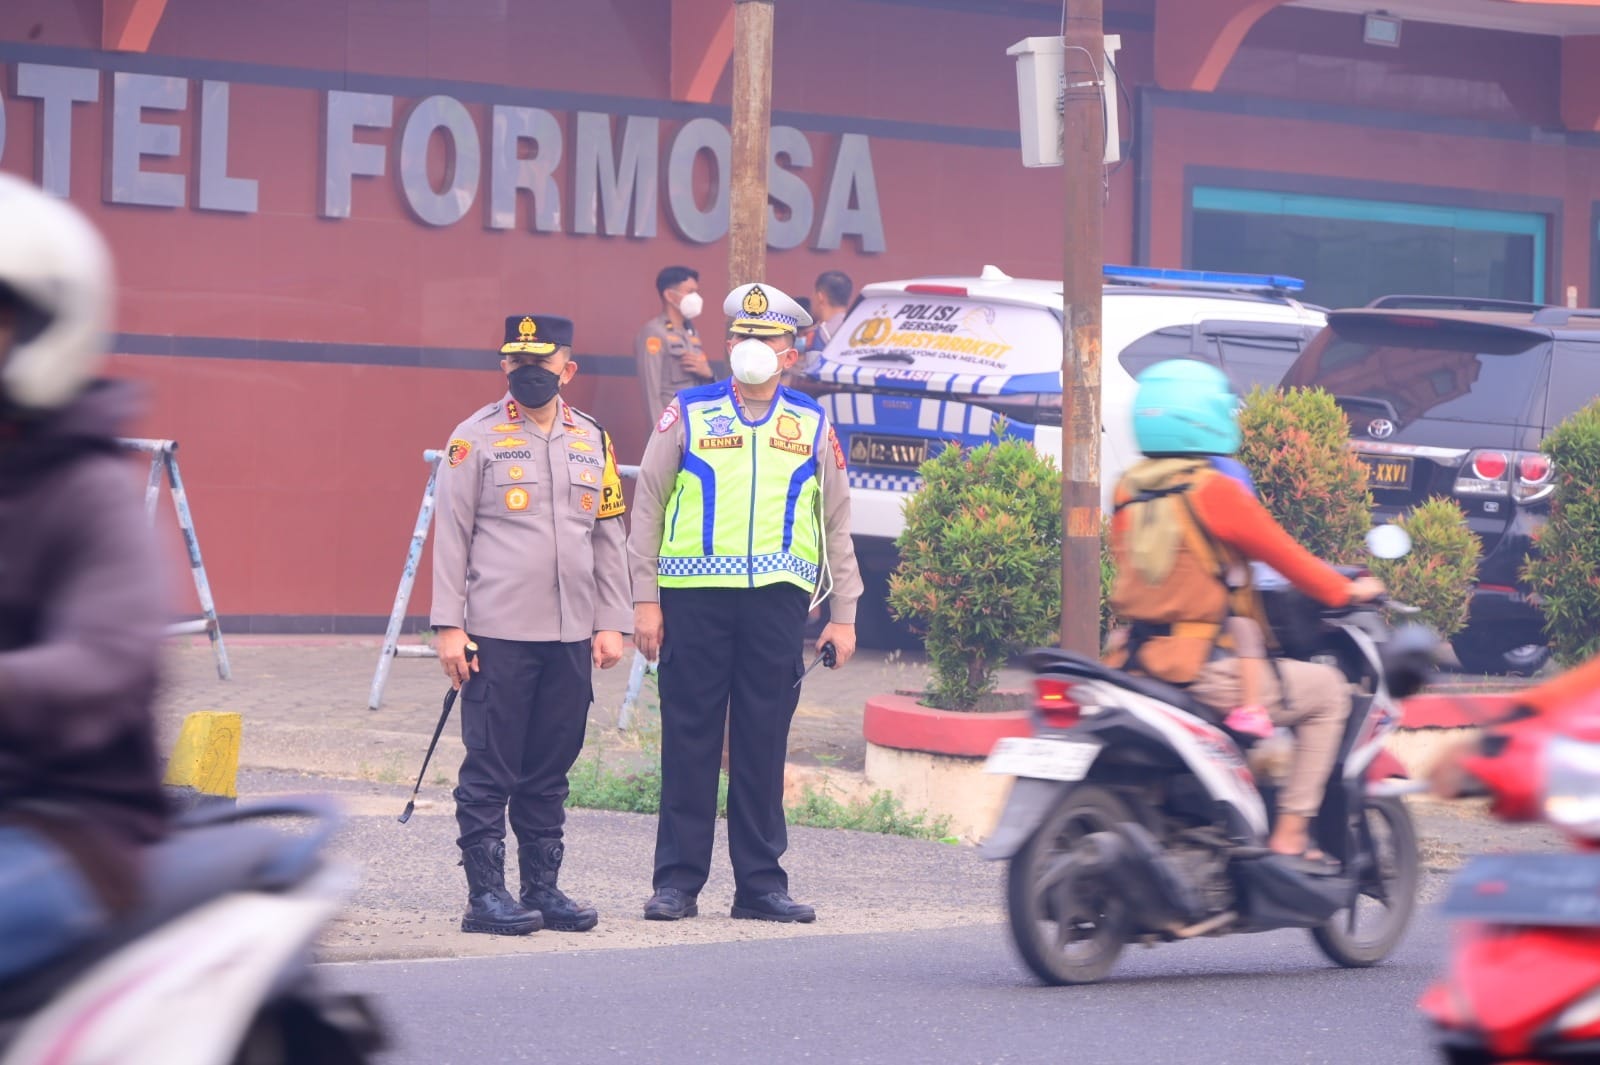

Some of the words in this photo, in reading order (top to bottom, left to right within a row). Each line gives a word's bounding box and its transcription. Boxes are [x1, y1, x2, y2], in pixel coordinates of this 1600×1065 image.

[0, 63, 259, 215] TEL
[323, 90, 886, 254] FORMOSA
[894, 304, 962, 322] POLISI
[898, 321, 958, 334] BERSAMA
[884, 332, 1013, 359] MASYARAKAT
[875, 368, 931, 381] POLISI
[703, 438, 739, 447] BENNY
[494, 450, 531, 460] WIDODO
[568, 453, 599, 466] POLRI
